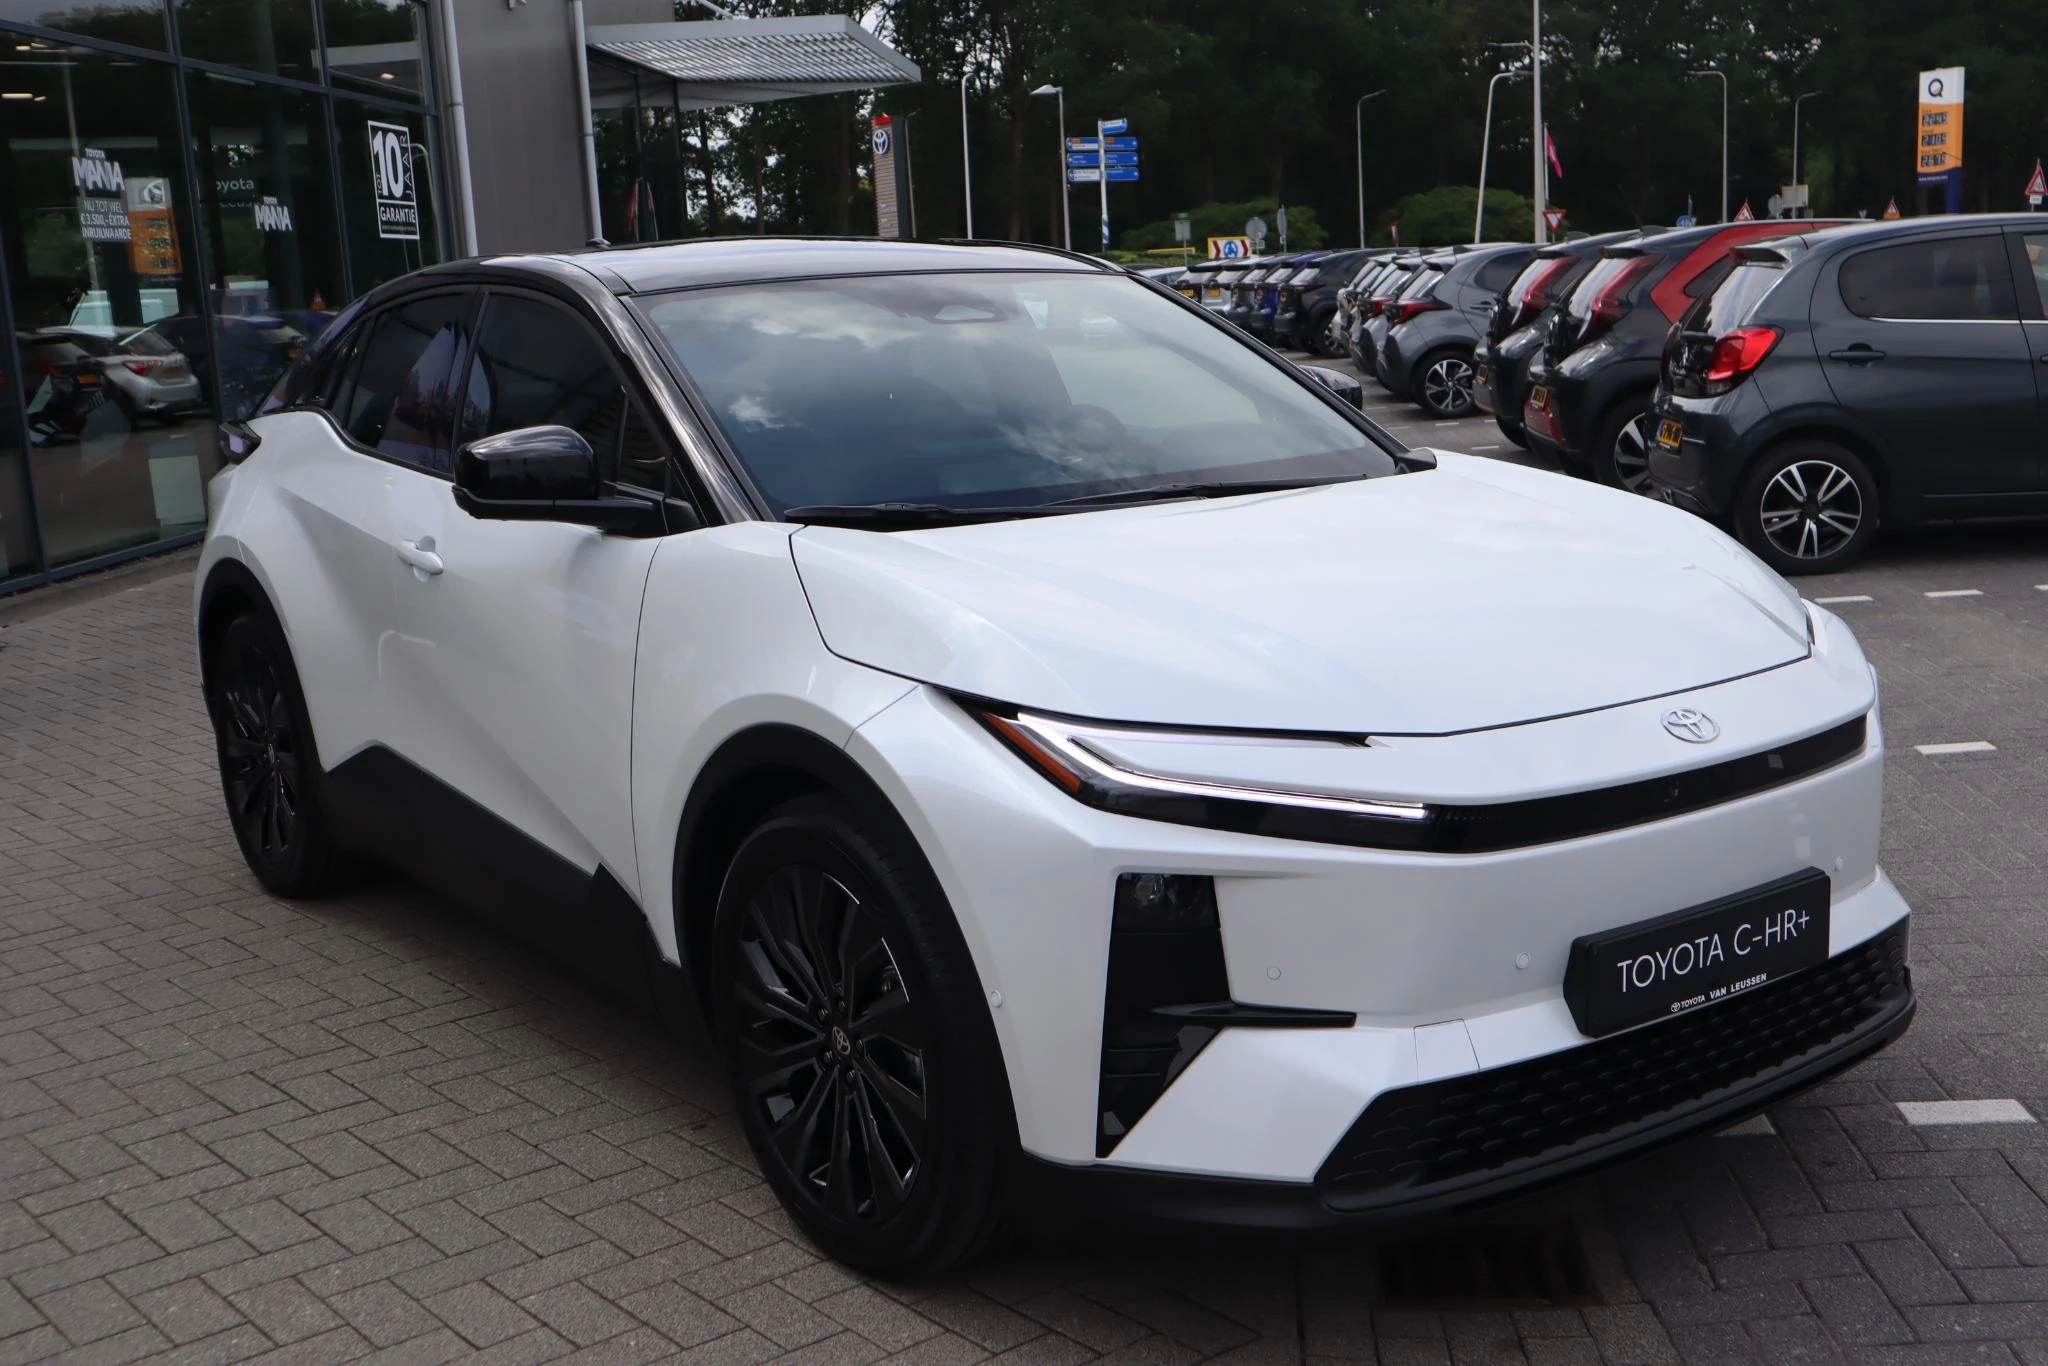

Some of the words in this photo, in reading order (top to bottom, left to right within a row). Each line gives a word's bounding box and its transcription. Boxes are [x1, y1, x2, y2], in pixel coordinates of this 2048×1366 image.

[85, 148, 106, 159] TOYOTA
[372, 130, 404, 198] 10
[400, 135, 413, 199] JAAR
[72, 156, 126, 192] MANIA
[83, 200, 95, 211] NU
[95, 200, 108, 213] TOT
[109, 202, 124, 213] WEL
[254, 204, 293, 232] MANIA
[380, 207, 416, 223] GARANTIE
[82, 226, 132, 240] INRUILWAARDE
[1617, 933, 1724, 993] TOYOTA
[1733, 909, 1811, 956] C-HR+
[1680, 994, 1706, 1009] TOYOTA
[1709, 986, 1727, 1000] VAN
[1730, 972, 1768, 992] LEUSSEN
